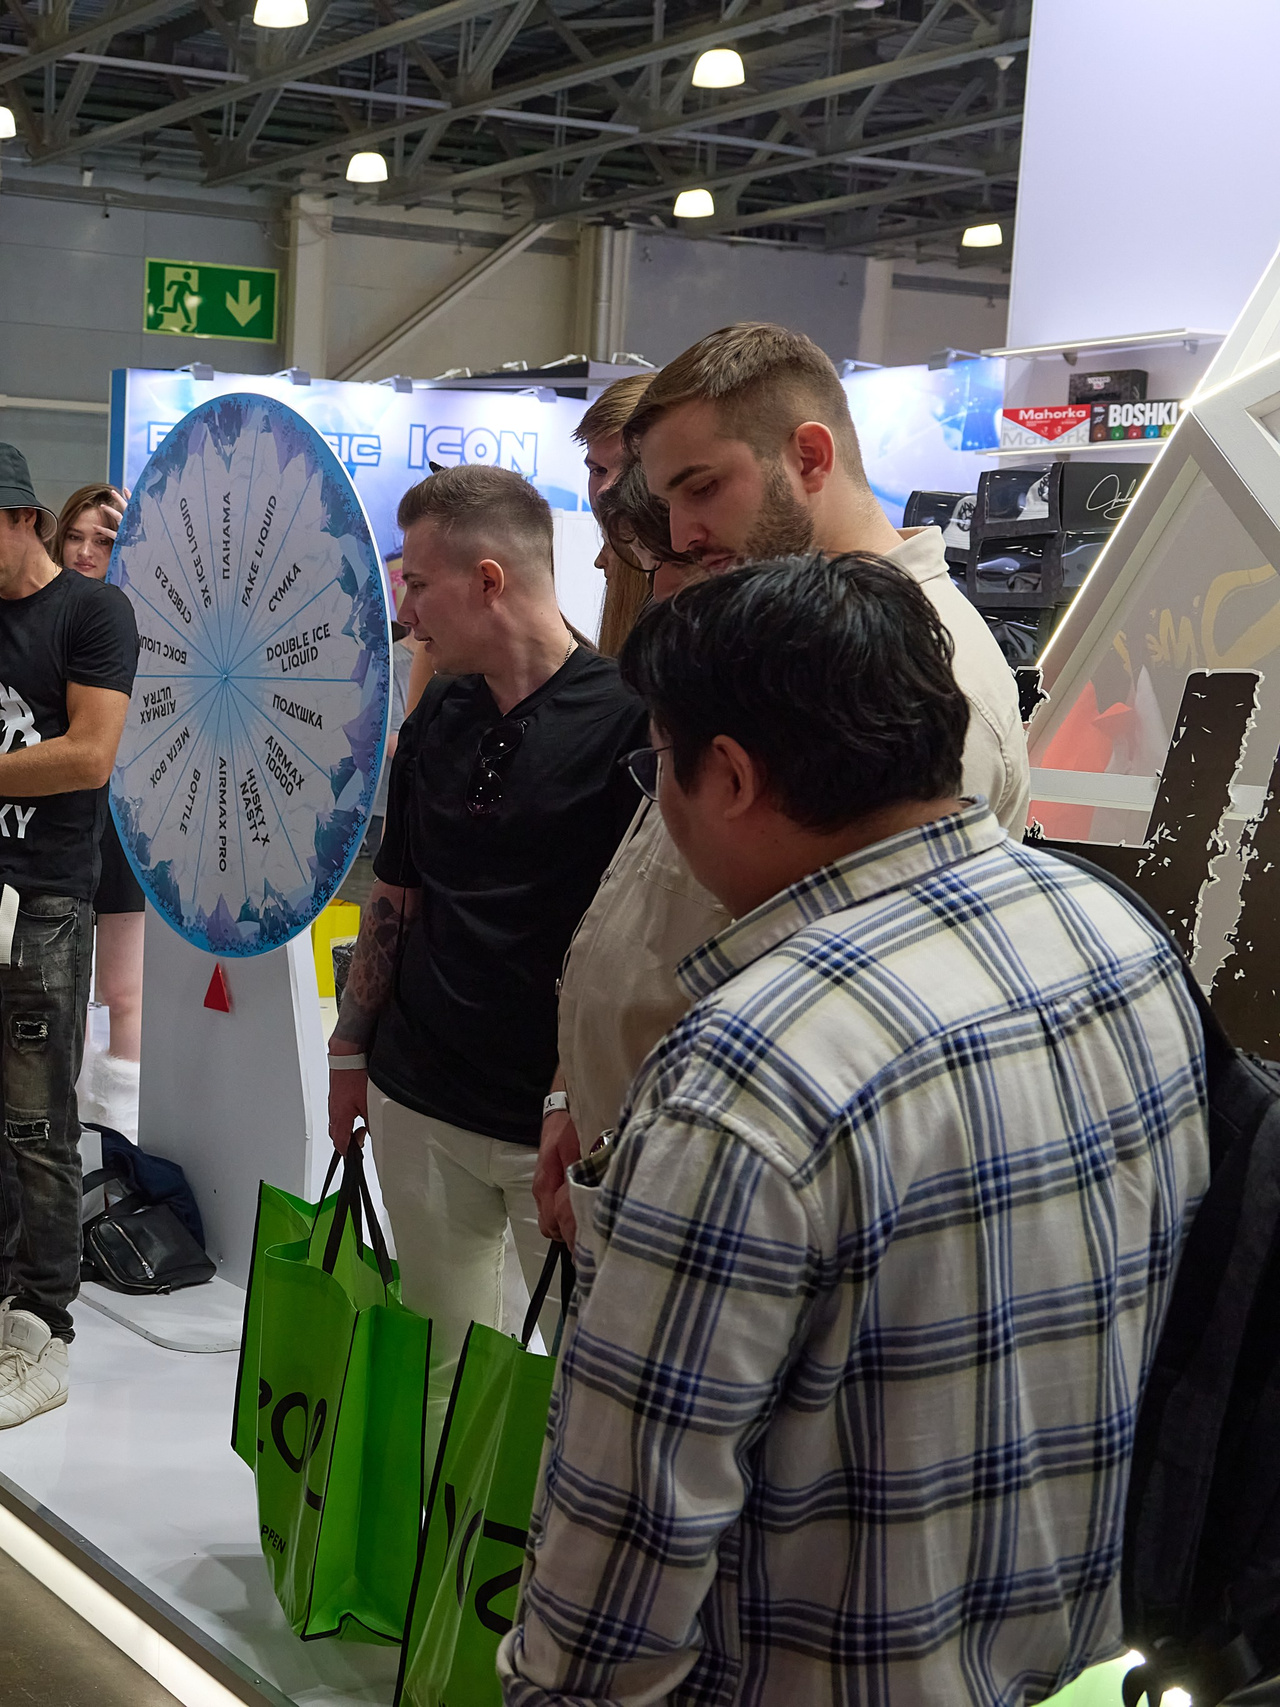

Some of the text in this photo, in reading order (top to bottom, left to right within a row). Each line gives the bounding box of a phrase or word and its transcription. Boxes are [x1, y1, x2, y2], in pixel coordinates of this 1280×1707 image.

[1019, 407, 1086, 420] Mahorka
[1108, 402, 1178, 427] BOSHKI
[408, 424, 538, 477] ICON
[179, 498, 198, 554] LIQUID
[223, 492, 231, 579] ПАНАМА
[193, 554, 206, 583] ICE
[241, 495, 277, 607] FAKE LIQUID
[155, 565, 192, 624] CYBER 2.0
[269, 563, 302, 612] СУМКА
[266, 623, 331, 662] DOUBLE ICE
[281, 646, 319, 673] LIQUID
[140, 700, 176, 724] AIRMAX
[143, 686, 171, 707] ULTRA
[273, 694, 323, 730] ПОДУШКА
[150, 760, 167, 788] BOX
[265, 735, 305, 790] AIRMAX
[266, 753, 294, 796] 10000
[179, 768, 201, 835] BOTTLE
[219, 756, 227, 872] AIRMAX PRO
[240, 781, 260, 843] NASTY
[246, 768, 270, 847] HUSKY X
